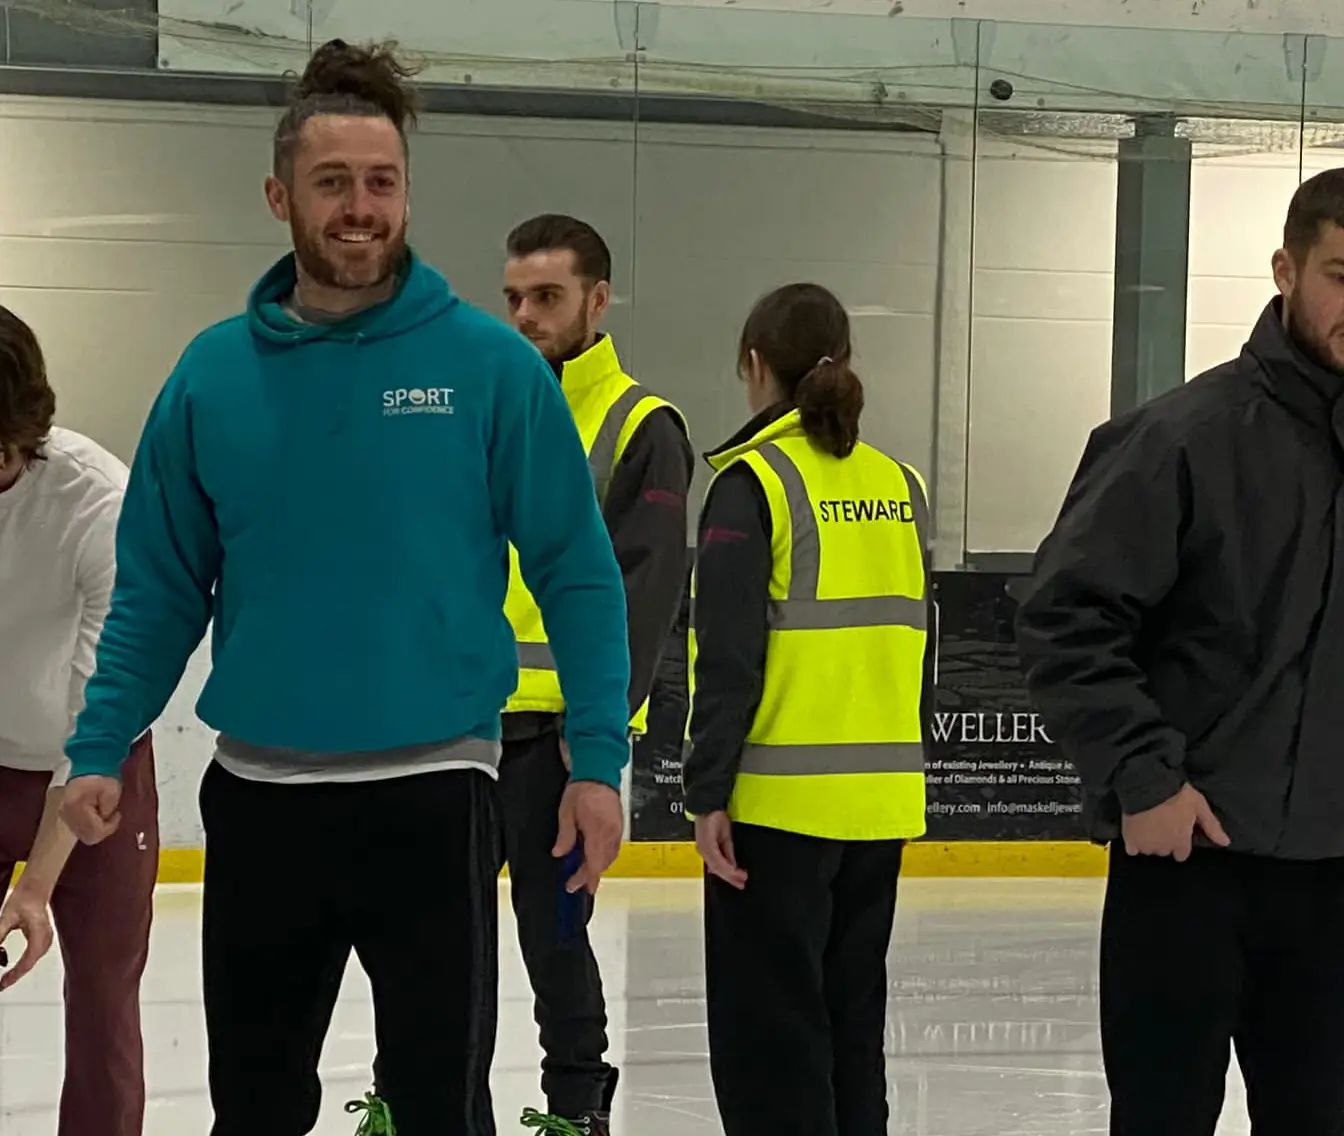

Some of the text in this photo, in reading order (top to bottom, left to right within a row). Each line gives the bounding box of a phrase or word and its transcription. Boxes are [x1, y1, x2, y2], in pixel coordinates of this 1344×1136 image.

[383, 388, 454, 407] SPORT
[819, 499, 915, 523] STEWARD
[955, 774, 997, 784] Diamonds
[1018, 774, 1054, 784] Precious
